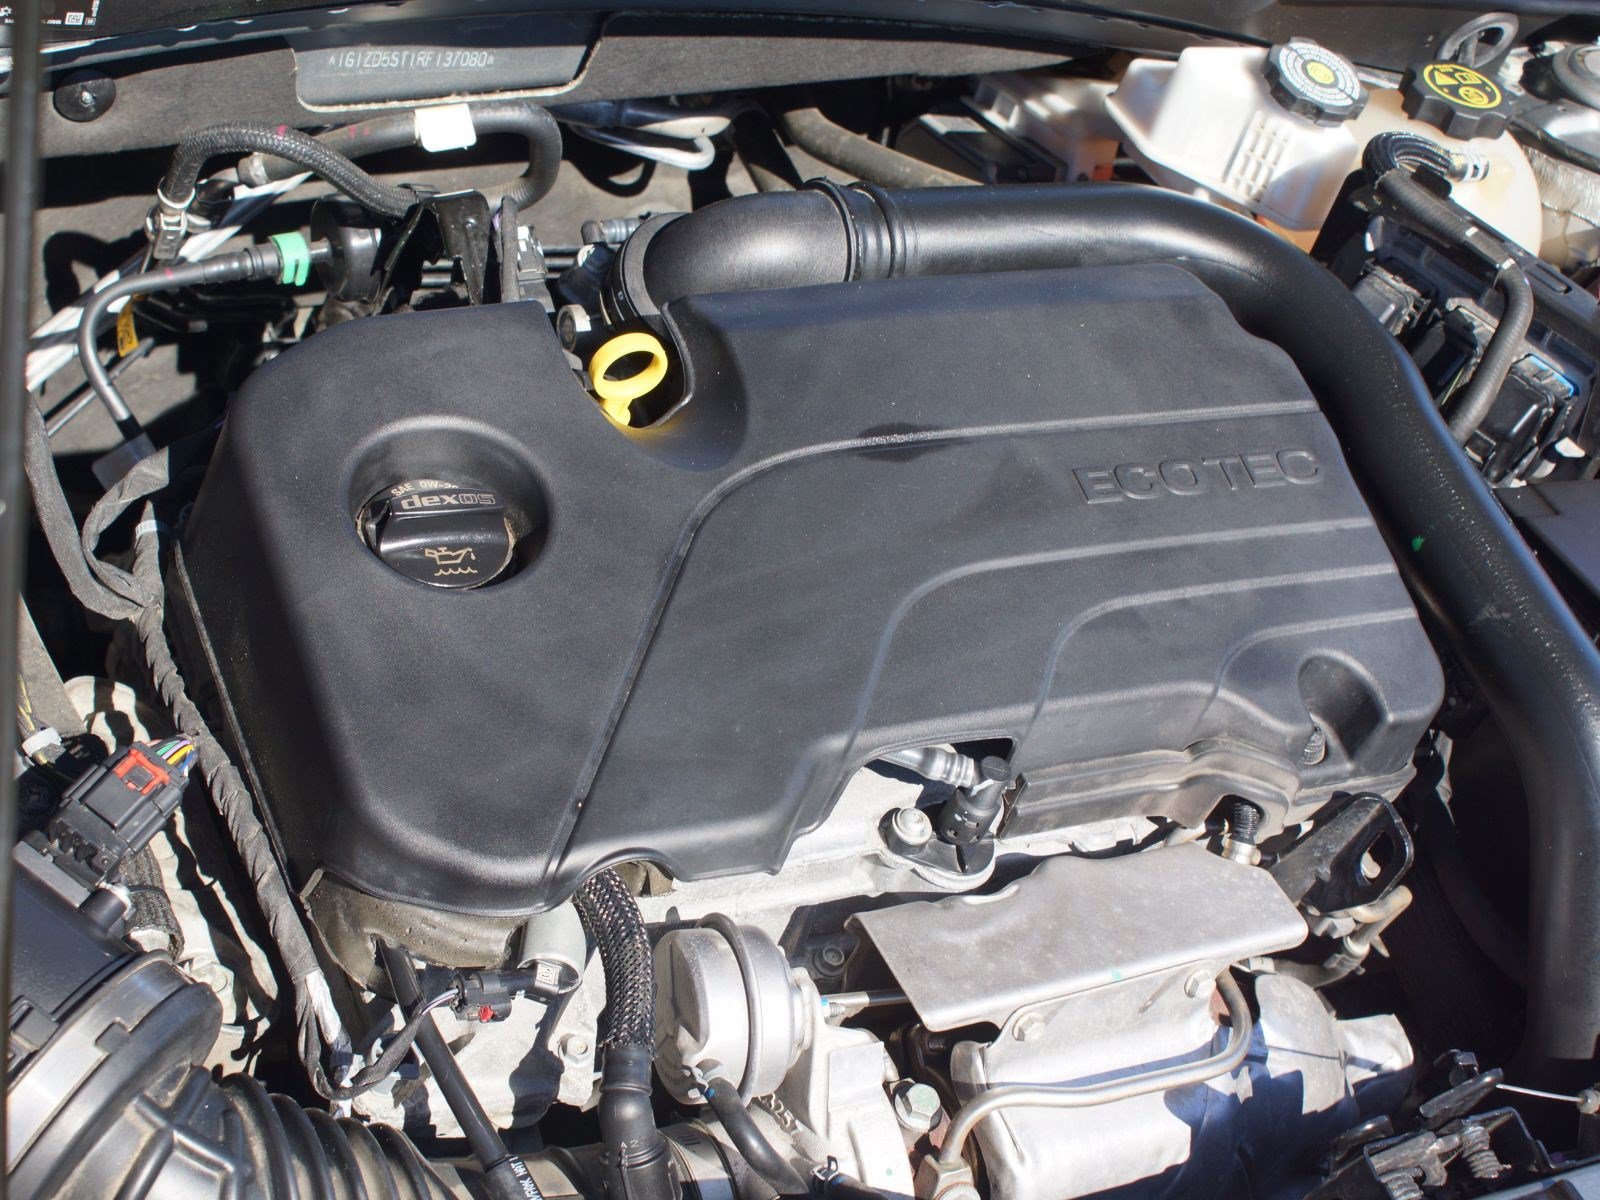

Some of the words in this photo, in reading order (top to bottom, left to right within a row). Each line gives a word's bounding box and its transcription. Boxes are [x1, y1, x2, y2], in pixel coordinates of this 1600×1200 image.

[1072, 450, 1322, 504] ECOTEC
[391, 482, 415, 497] SAE
[401, 493, 496, 510] dexos
